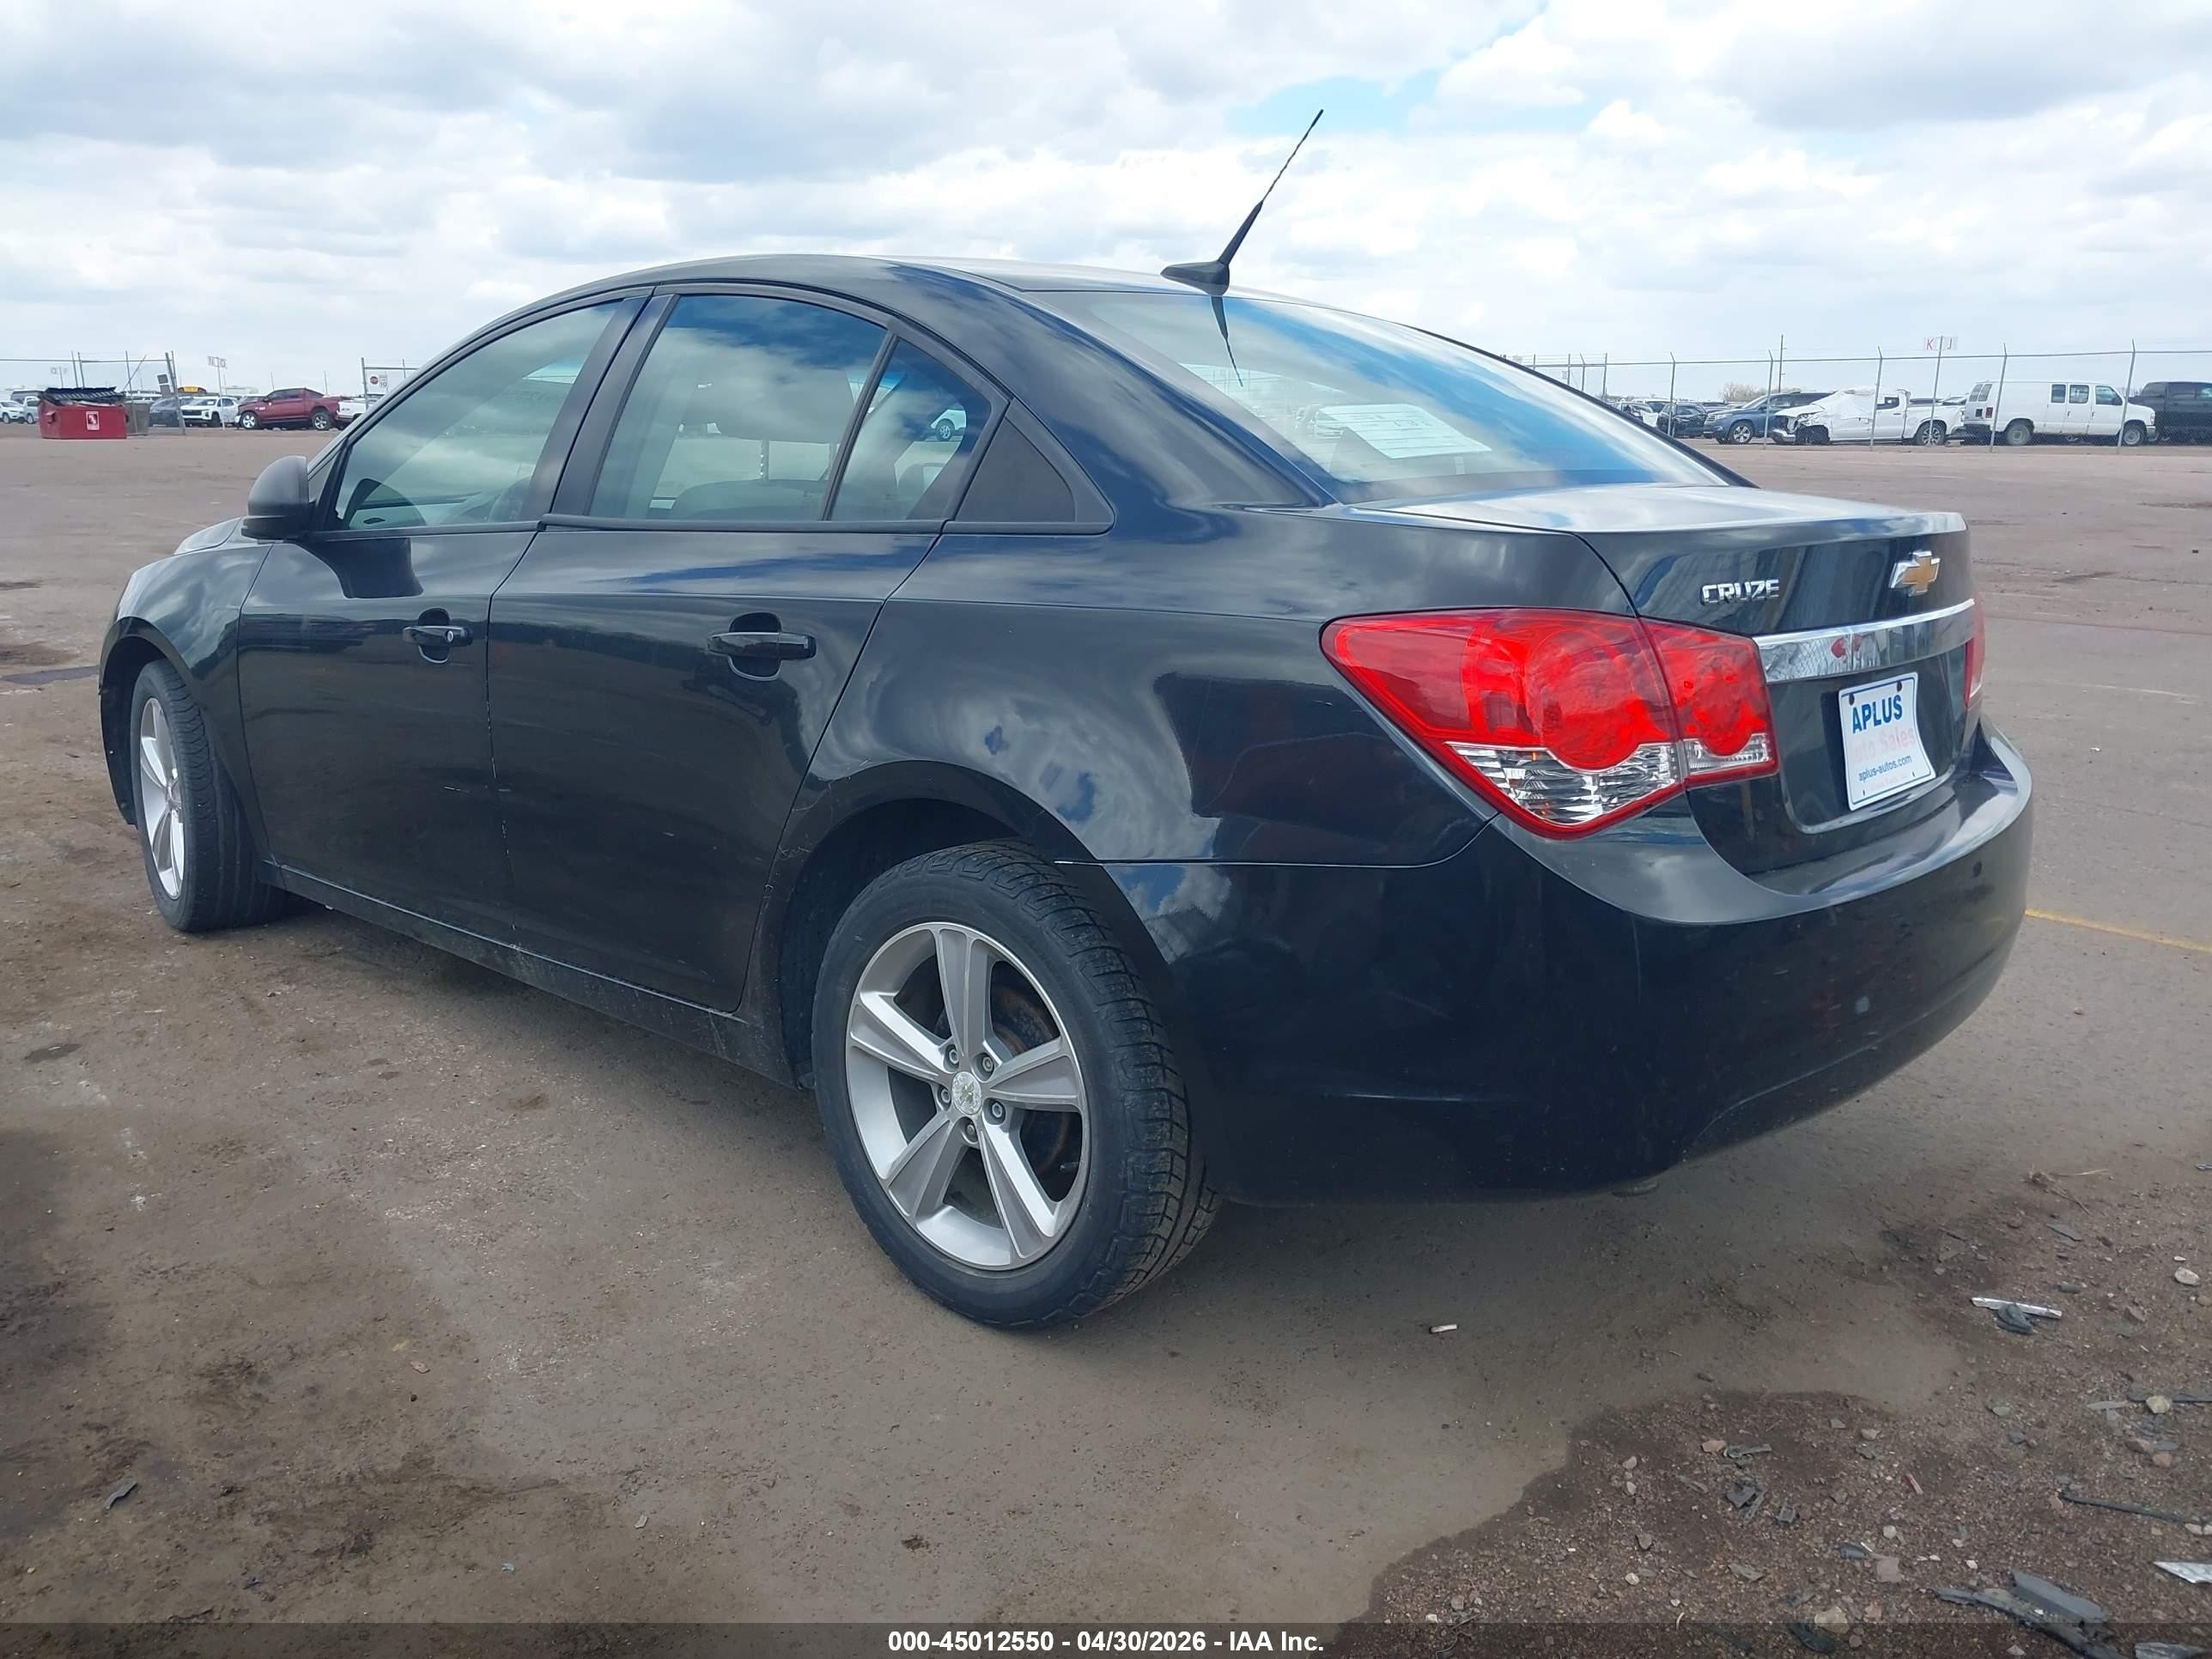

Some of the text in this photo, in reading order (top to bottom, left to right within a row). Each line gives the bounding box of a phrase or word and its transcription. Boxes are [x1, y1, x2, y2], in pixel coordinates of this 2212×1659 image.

[1926, 337, 1953, 350] K J
[1701, 579, 1779, 604] CRUZE
[1851, 694, 1904, 734] APLUS
[1858, 755, 1912, 782] aplus-autos.com
